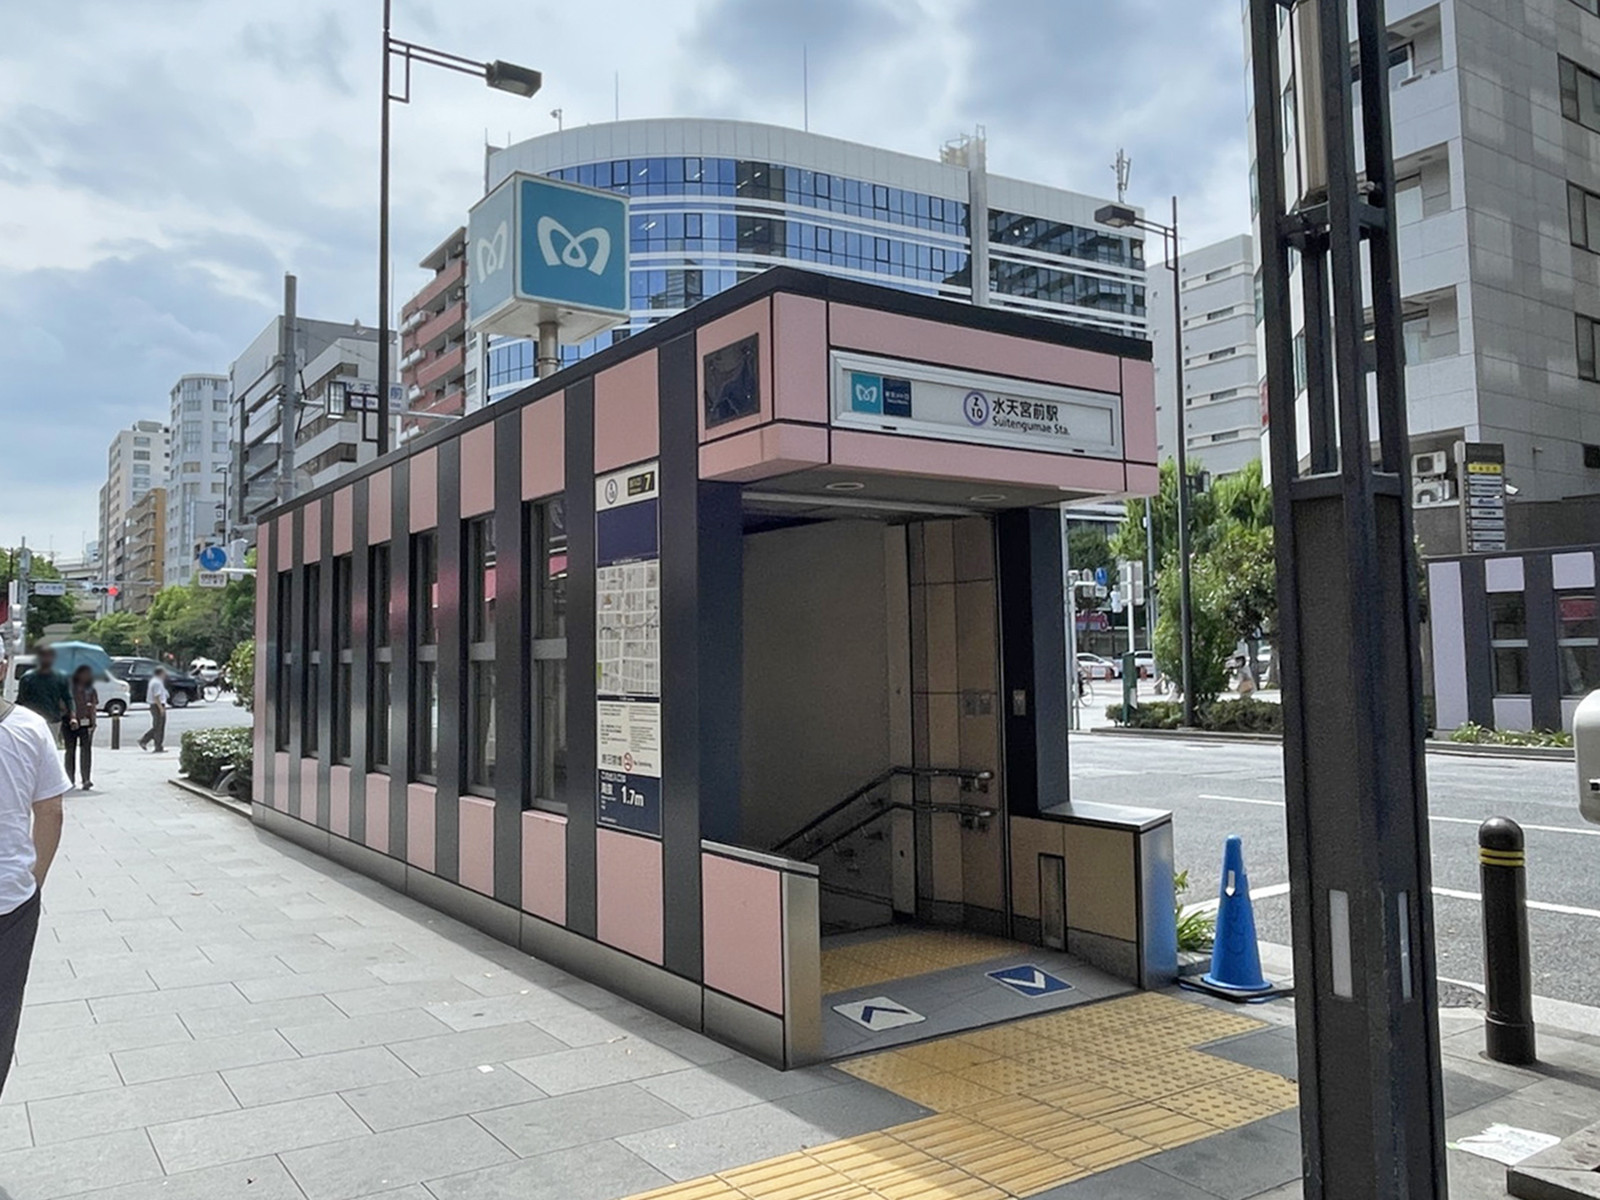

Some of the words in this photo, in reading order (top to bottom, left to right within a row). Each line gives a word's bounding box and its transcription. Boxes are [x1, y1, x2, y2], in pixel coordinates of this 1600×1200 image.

[973, 397, 979, 407] Z
[992, 397, 1059, 422] 水天宮前駅
[971, 407, 984, 419] 10
[992, 415, 1052, 434] Suitengumae
[1053, 423, 1071, 436] Sta.
[644, 474, 651, 491] 7
[621, 785, 645, 807] 1.7m
